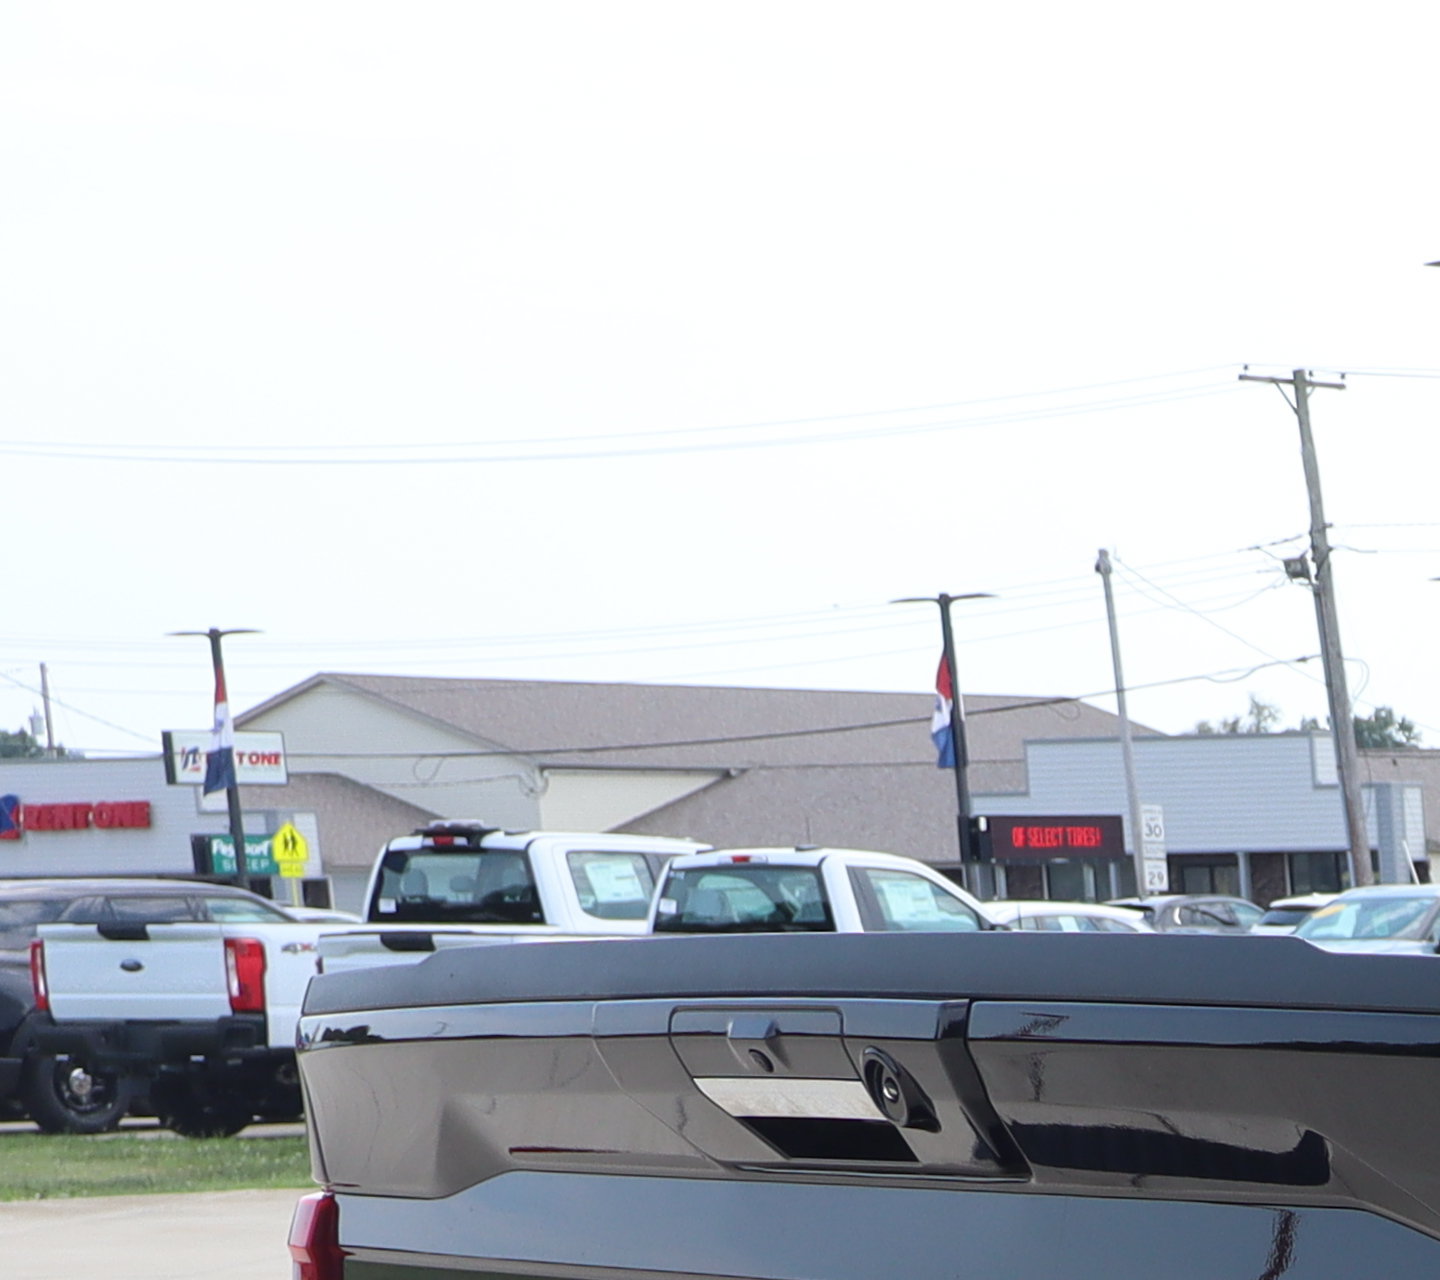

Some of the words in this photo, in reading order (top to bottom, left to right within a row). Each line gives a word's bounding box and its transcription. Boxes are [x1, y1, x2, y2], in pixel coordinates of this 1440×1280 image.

[249, 752, 282, 766] ONE
[94, 801, 151, 829] ONE
[1027, 826, 1064, 848] SELECT
[1144, 822, 1163, 838] 30
[1148, 870, 1165, 887] 29
